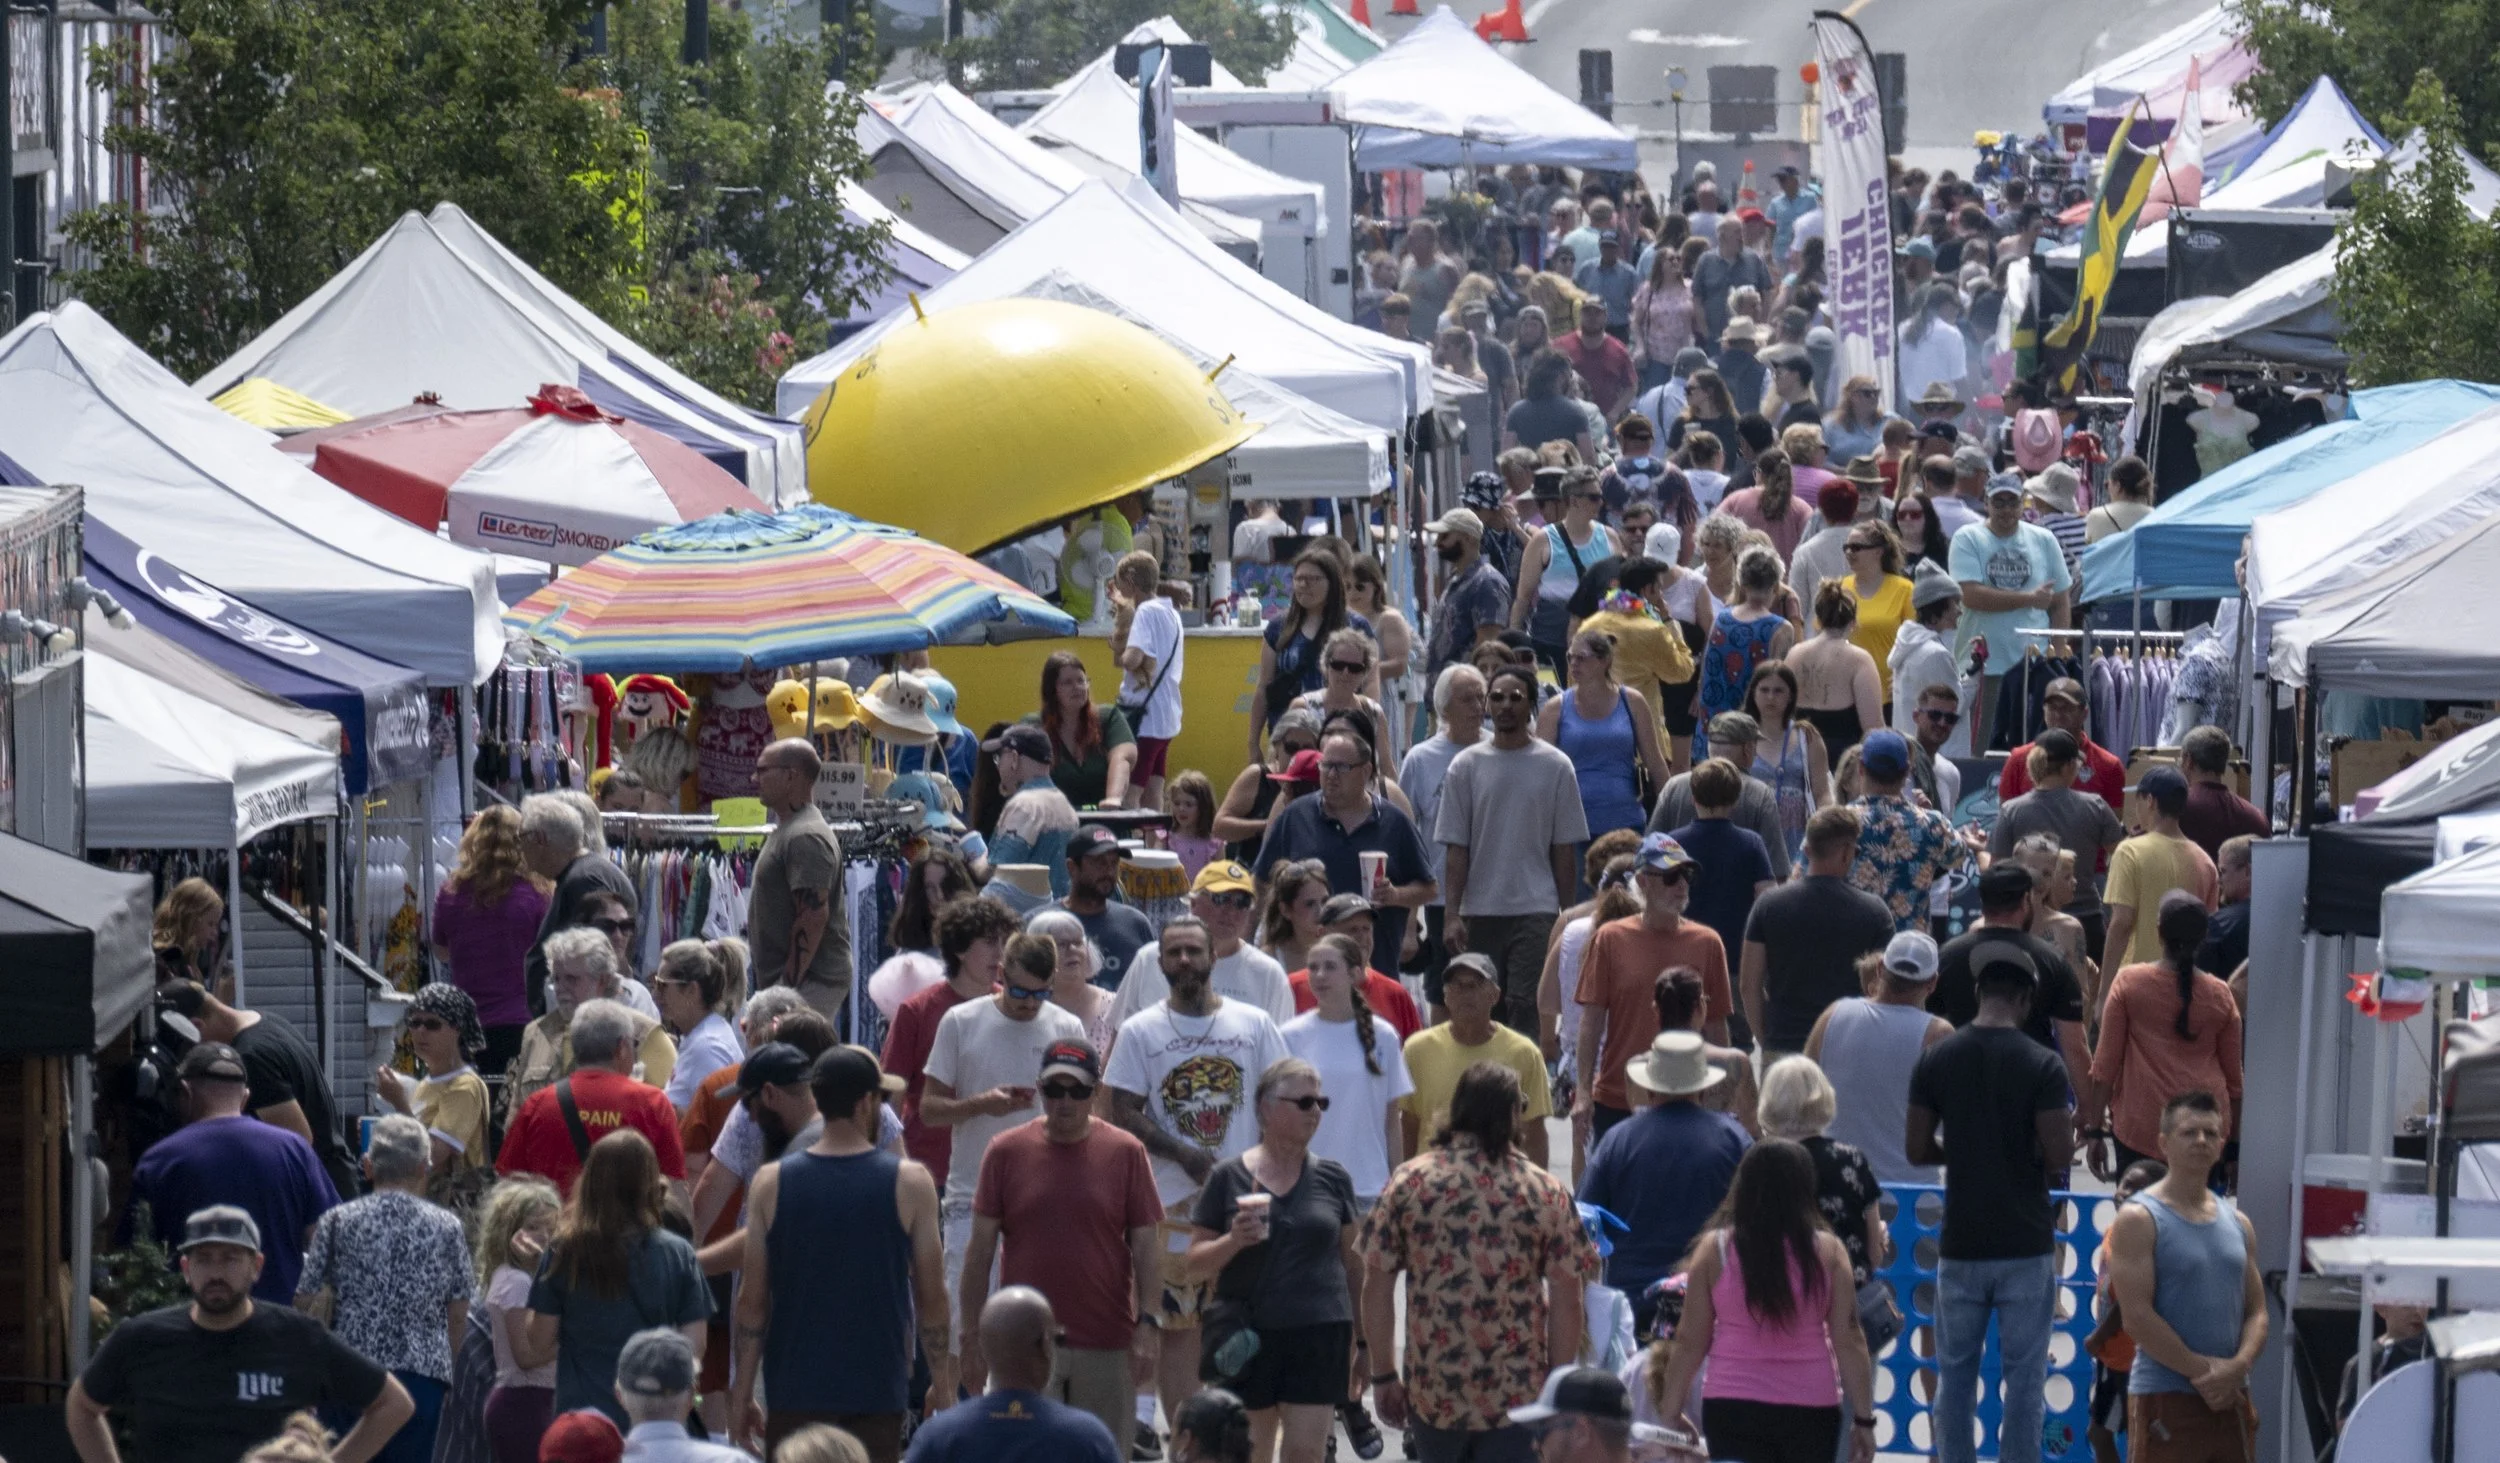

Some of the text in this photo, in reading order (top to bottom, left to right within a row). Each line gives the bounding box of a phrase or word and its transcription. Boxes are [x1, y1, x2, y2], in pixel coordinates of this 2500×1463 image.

[557, 528, 609, 552] SMOKED
[579, 1109, 622, 1128] PAIN
[236, 1371, 284, 1402] Lite
